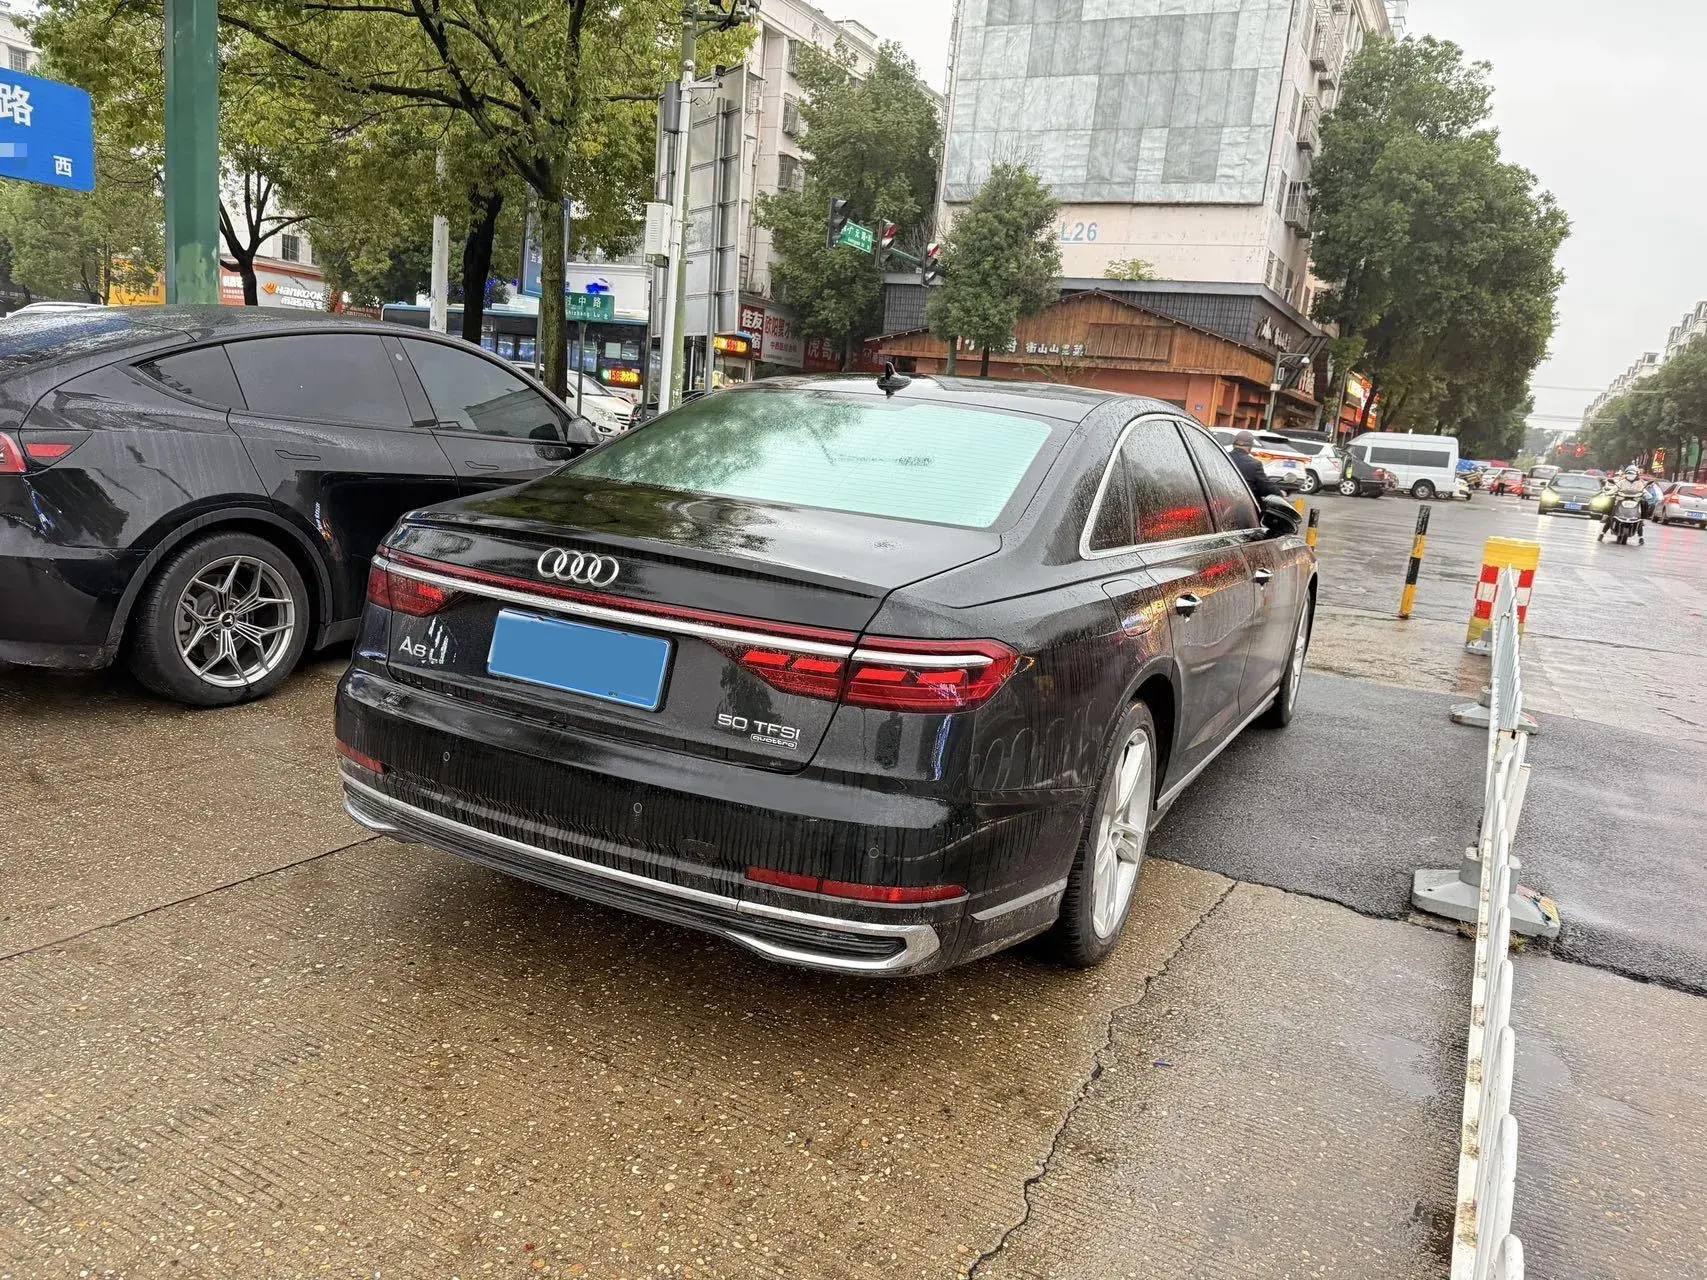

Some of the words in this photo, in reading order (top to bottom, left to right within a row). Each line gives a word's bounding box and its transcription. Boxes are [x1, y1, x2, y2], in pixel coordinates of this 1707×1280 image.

[53, 155, 73, 178] 西
[718, 713, 748, 730] 50
[753, 720, 801, 741] TFSI
[752, 735, 795, 748] quattro
